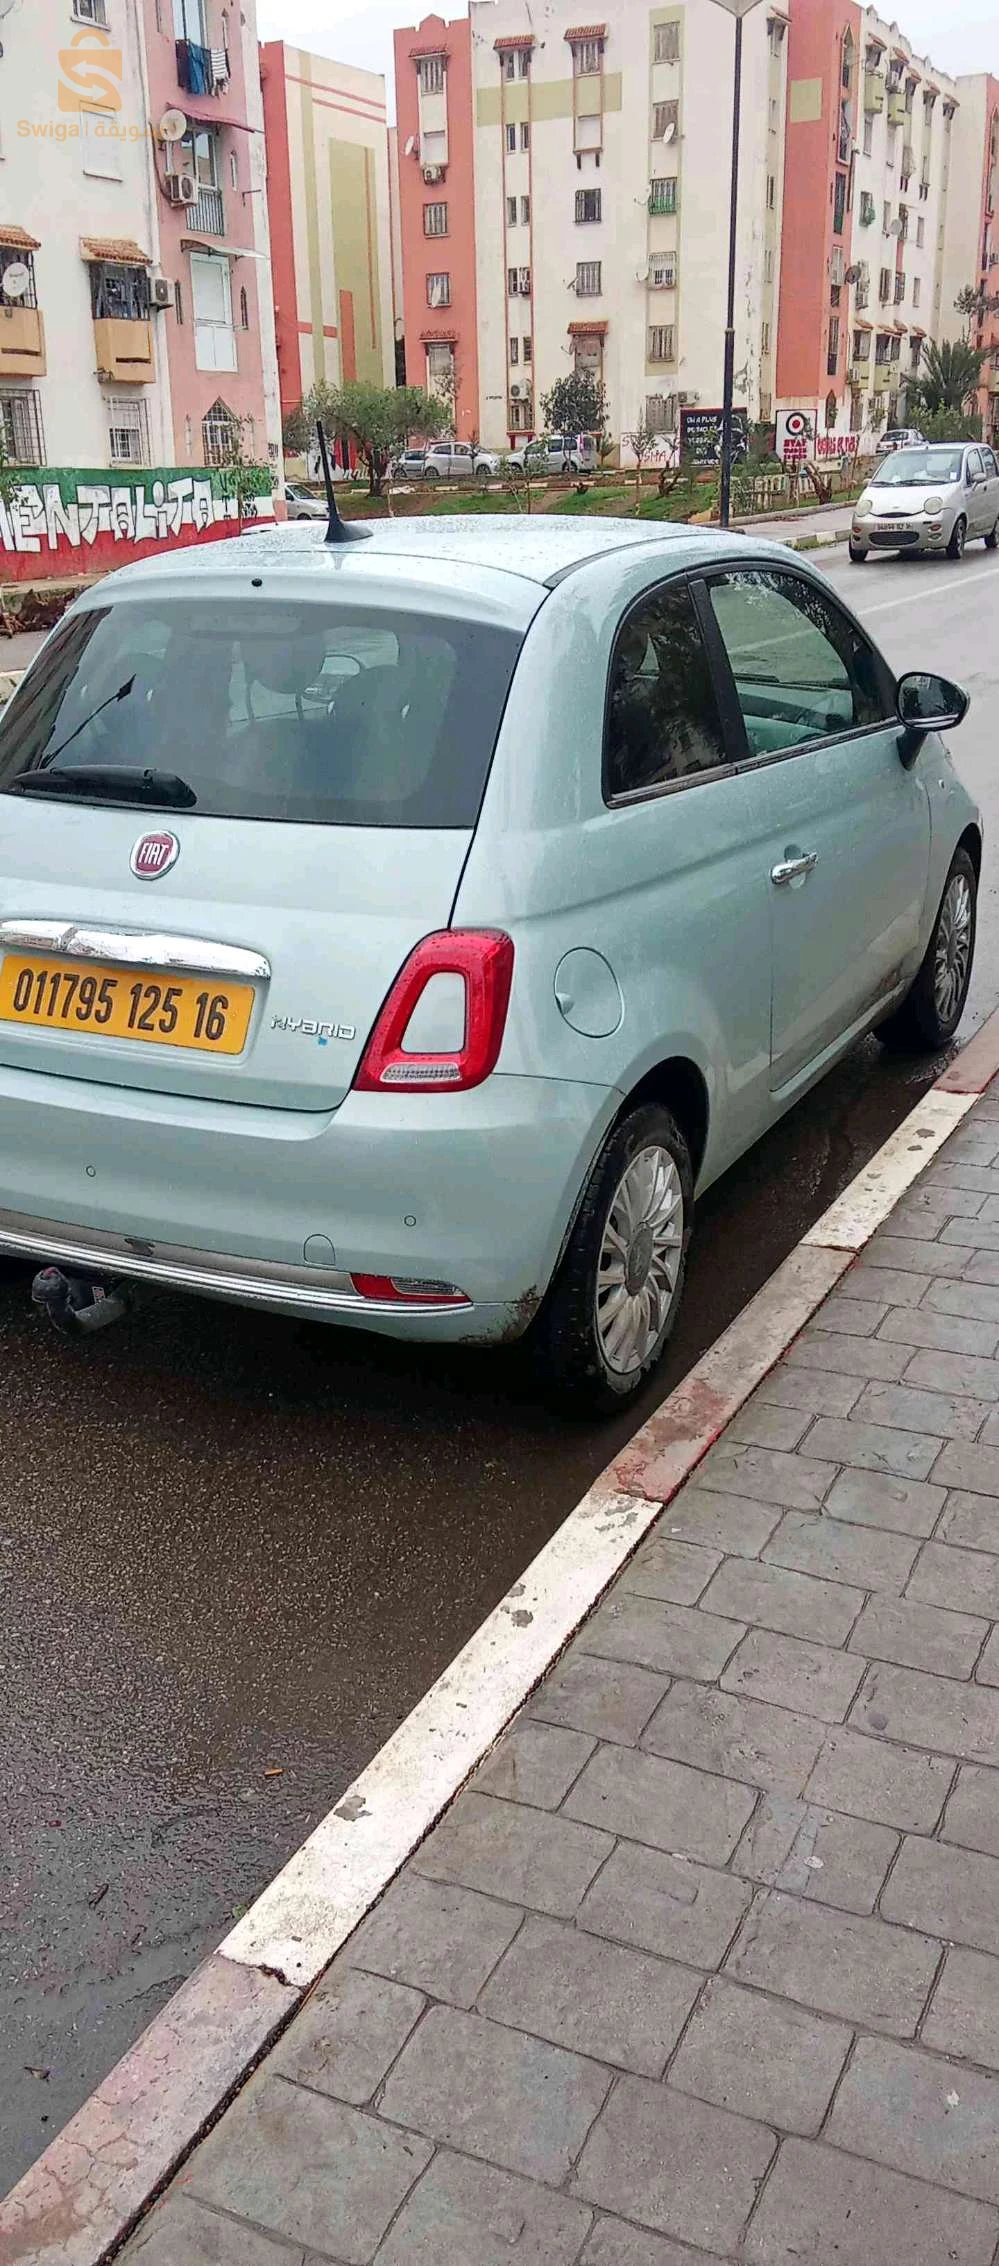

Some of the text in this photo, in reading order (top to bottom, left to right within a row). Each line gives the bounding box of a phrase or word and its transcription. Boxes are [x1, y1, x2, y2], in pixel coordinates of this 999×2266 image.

[138, 841, 170, 866] FIAT
[13, 967, 229, 1041] 011795 125 16
